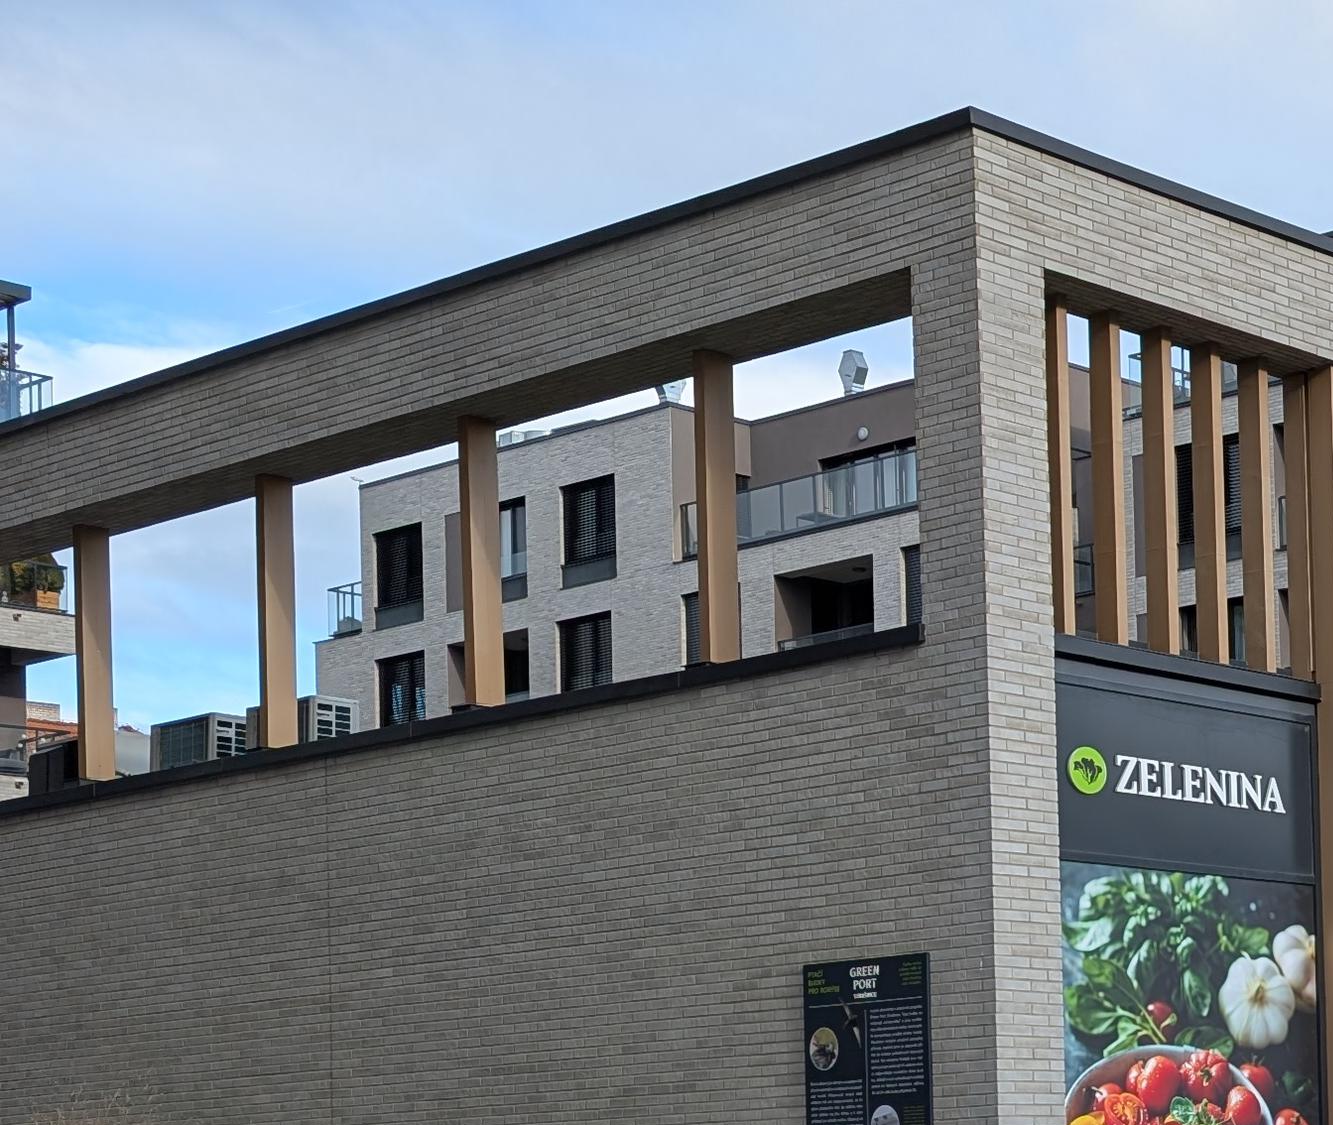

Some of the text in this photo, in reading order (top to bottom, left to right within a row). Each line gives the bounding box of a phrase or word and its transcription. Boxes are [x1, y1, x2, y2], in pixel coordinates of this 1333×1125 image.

[1114, 754, 1286, 814] ZELENINA
[849, 965, 880, 978] GREEN
[852, 978, 877, 990] PORT
